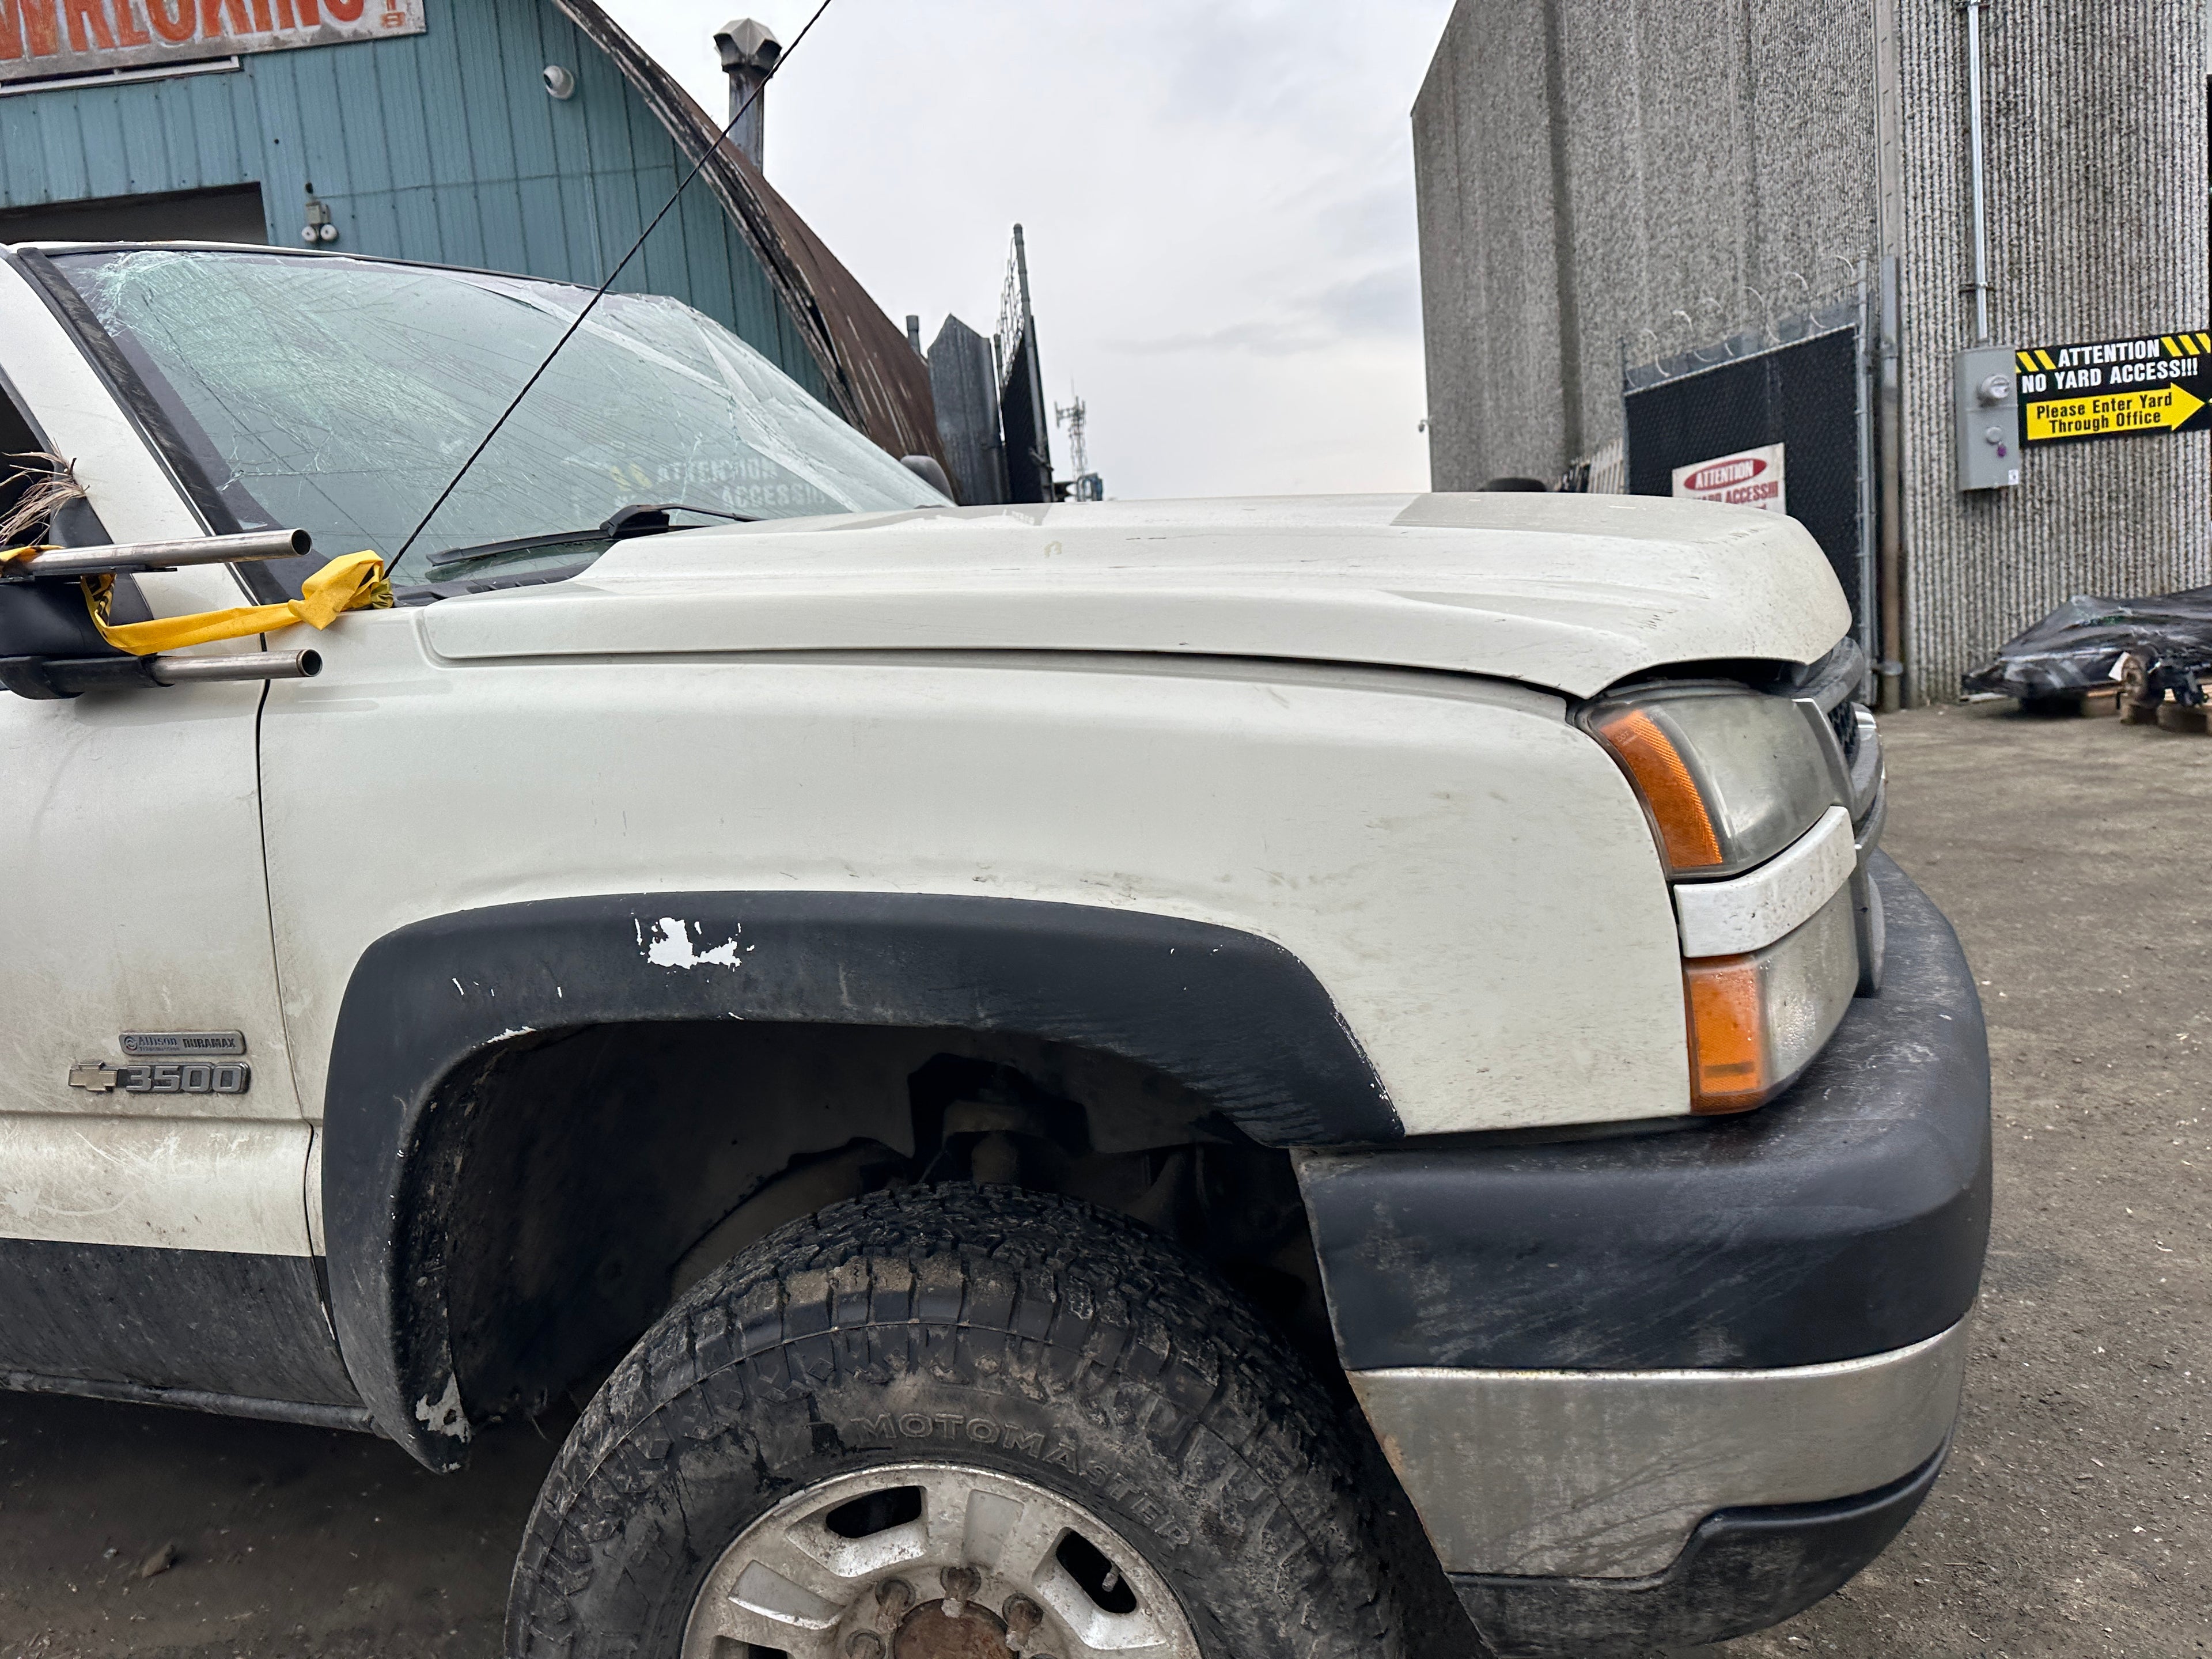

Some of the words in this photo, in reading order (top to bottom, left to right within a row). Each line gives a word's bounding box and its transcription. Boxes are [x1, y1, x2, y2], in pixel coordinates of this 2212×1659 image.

[2058, 339, 2160, 368] ATTENTION
[2021, 373, 2047, 393] NO
[2054, 368, 2102, 390] YARD
[2109, 358, 2198, 384] ACCESS!!!
[2037, 403, 2086, 420] Please
[2092, 397, 2133, 413] Enter
[2139, 392, 2172, 408] Yard
[2049, 417, 2109, 433] Through
[2116, 412, 2161, 427] Office
[1695, 460, 1753, 490] ATTENTION
[138, 1036, 177, 1046] Allison
[182, 1038, 236, 1048] DURAMAX
[126, 1066, 243, 1092] 3500
